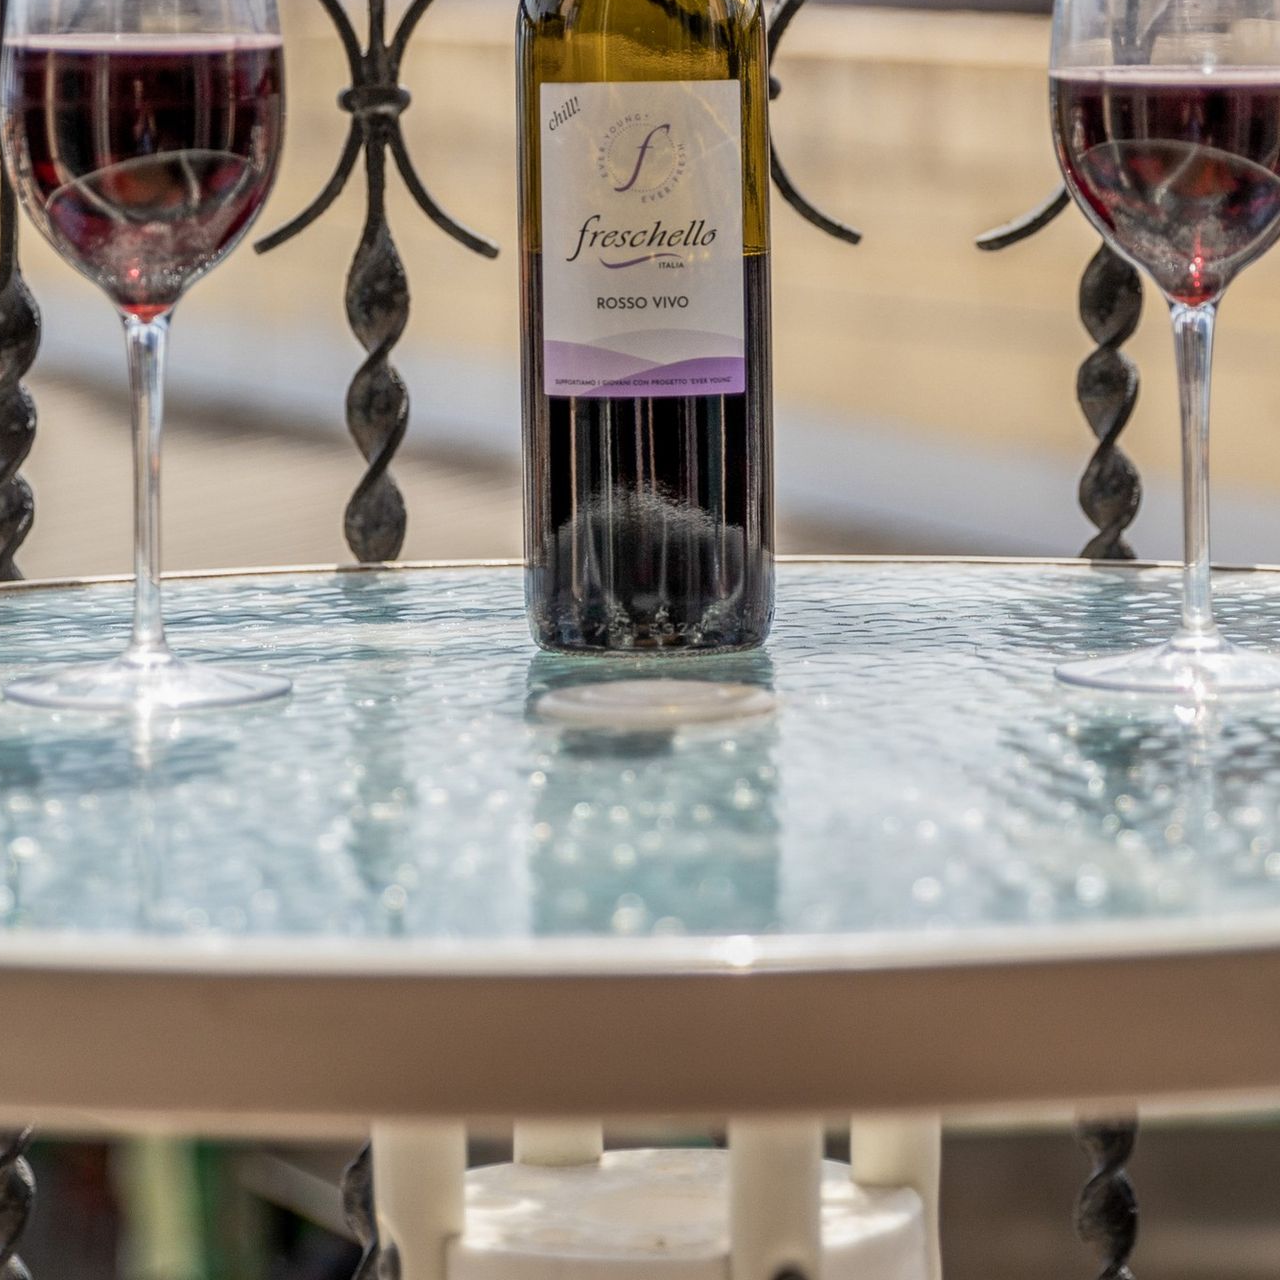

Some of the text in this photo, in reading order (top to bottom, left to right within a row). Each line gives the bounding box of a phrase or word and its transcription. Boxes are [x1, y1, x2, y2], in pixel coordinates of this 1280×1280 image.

[548, 96, 581, 131] chill!
[566, 214, 718, 262] freschello
[658, 261, 685, 269] ITALIA
[596, 295, 689, 309] ROSSO VIVO
